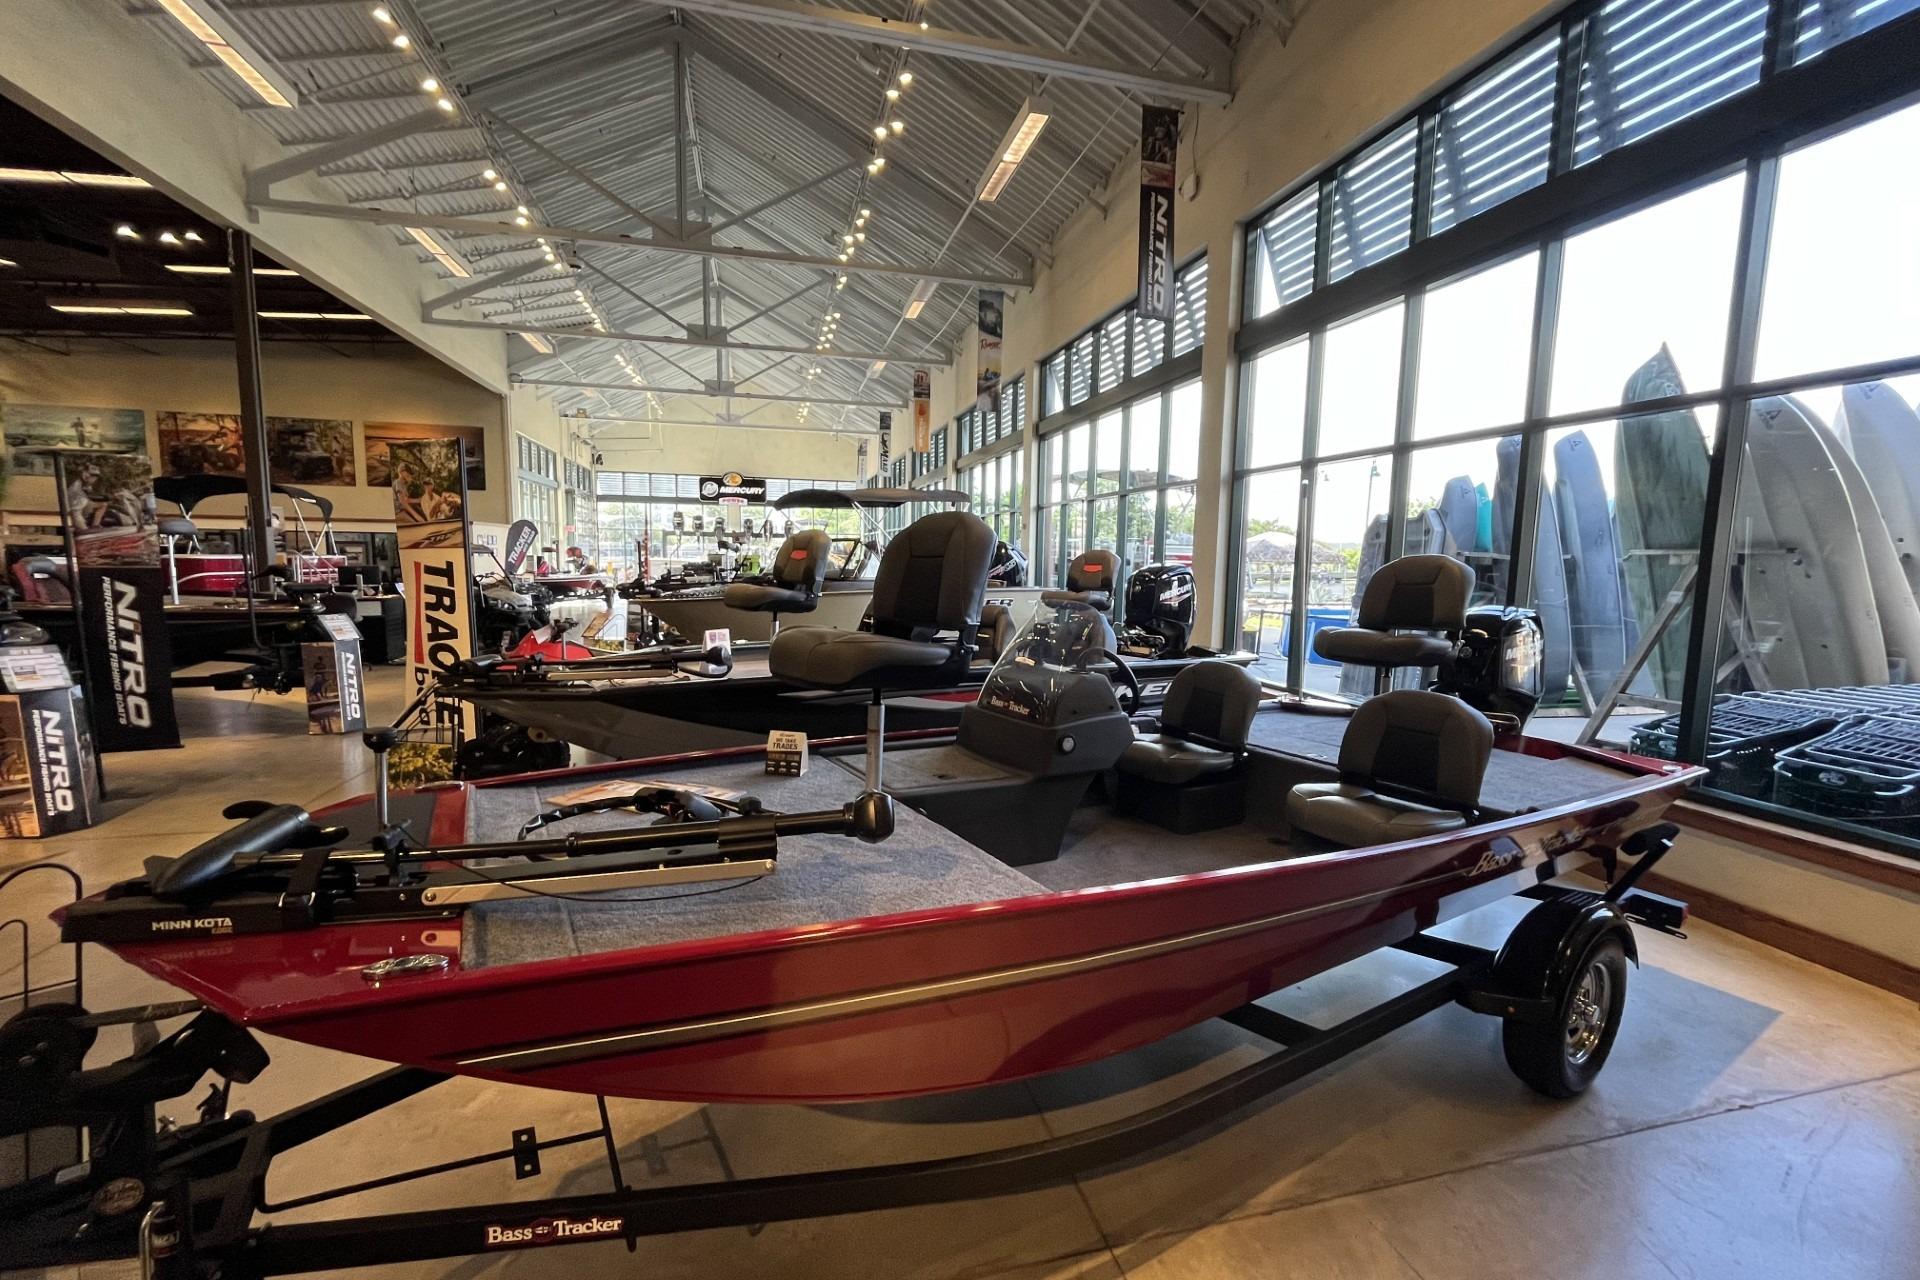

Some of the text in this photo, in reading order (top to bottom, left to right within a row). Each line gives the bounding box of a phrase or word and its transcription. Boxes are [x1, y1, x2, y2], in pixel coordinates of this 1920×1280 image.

[719, 486, 765, 495] MERCURY
[508, 526, 531, 564] TRACKER
[101, 575, 127, 726] PERFORMANCE FISHING BOATS
[113, 580, 152, 729] NITRO
[424, 560, 465, 741] TRACE
[41, 710, 75, 812] NITRO
[151, 917, 233, 931] MINN KOTA
[487, 1218, 622, 1244] Bass Tracker
